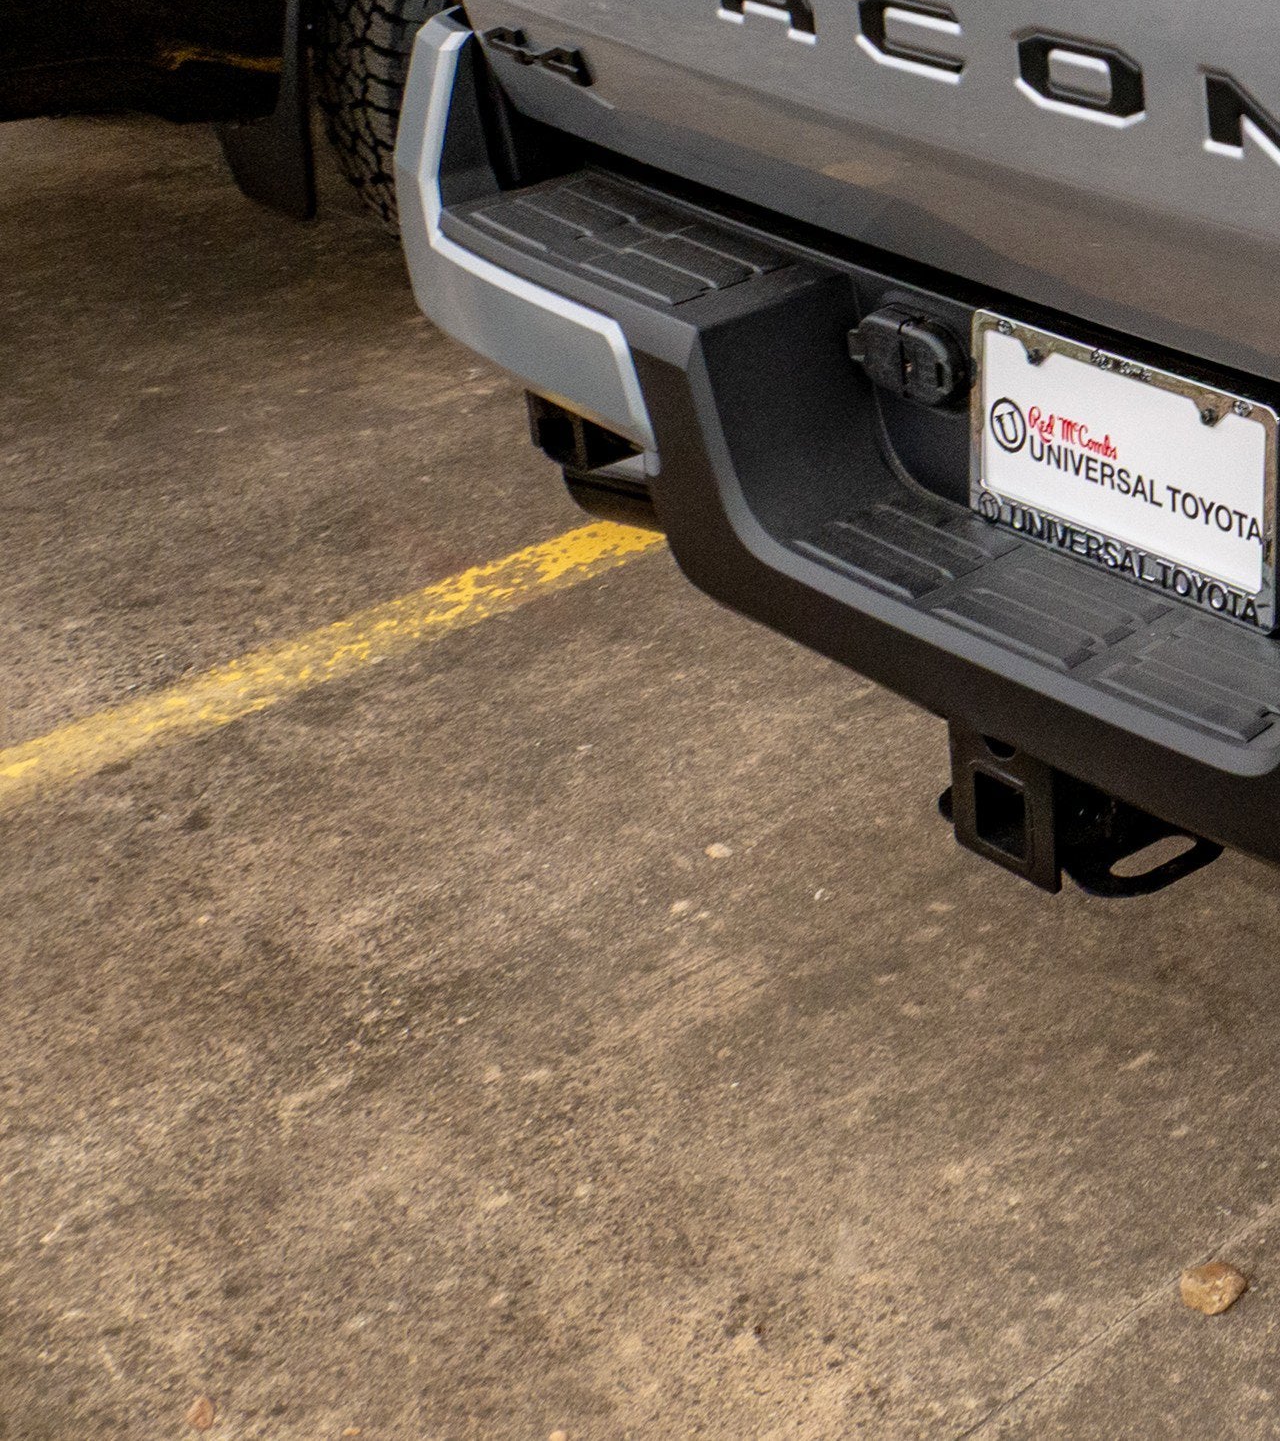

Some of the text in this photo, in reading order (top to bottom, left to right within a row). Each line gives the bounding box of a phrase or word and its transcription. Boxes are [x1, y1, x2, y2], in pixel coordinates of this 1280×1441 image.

[1028, 405, 1118, 461] Red McCombs
[1029, 434, 1265, 547] UNIVERSAL TOYOTA
[1008, 502, 1262, 627] UNIVERSAL TOYOTA
